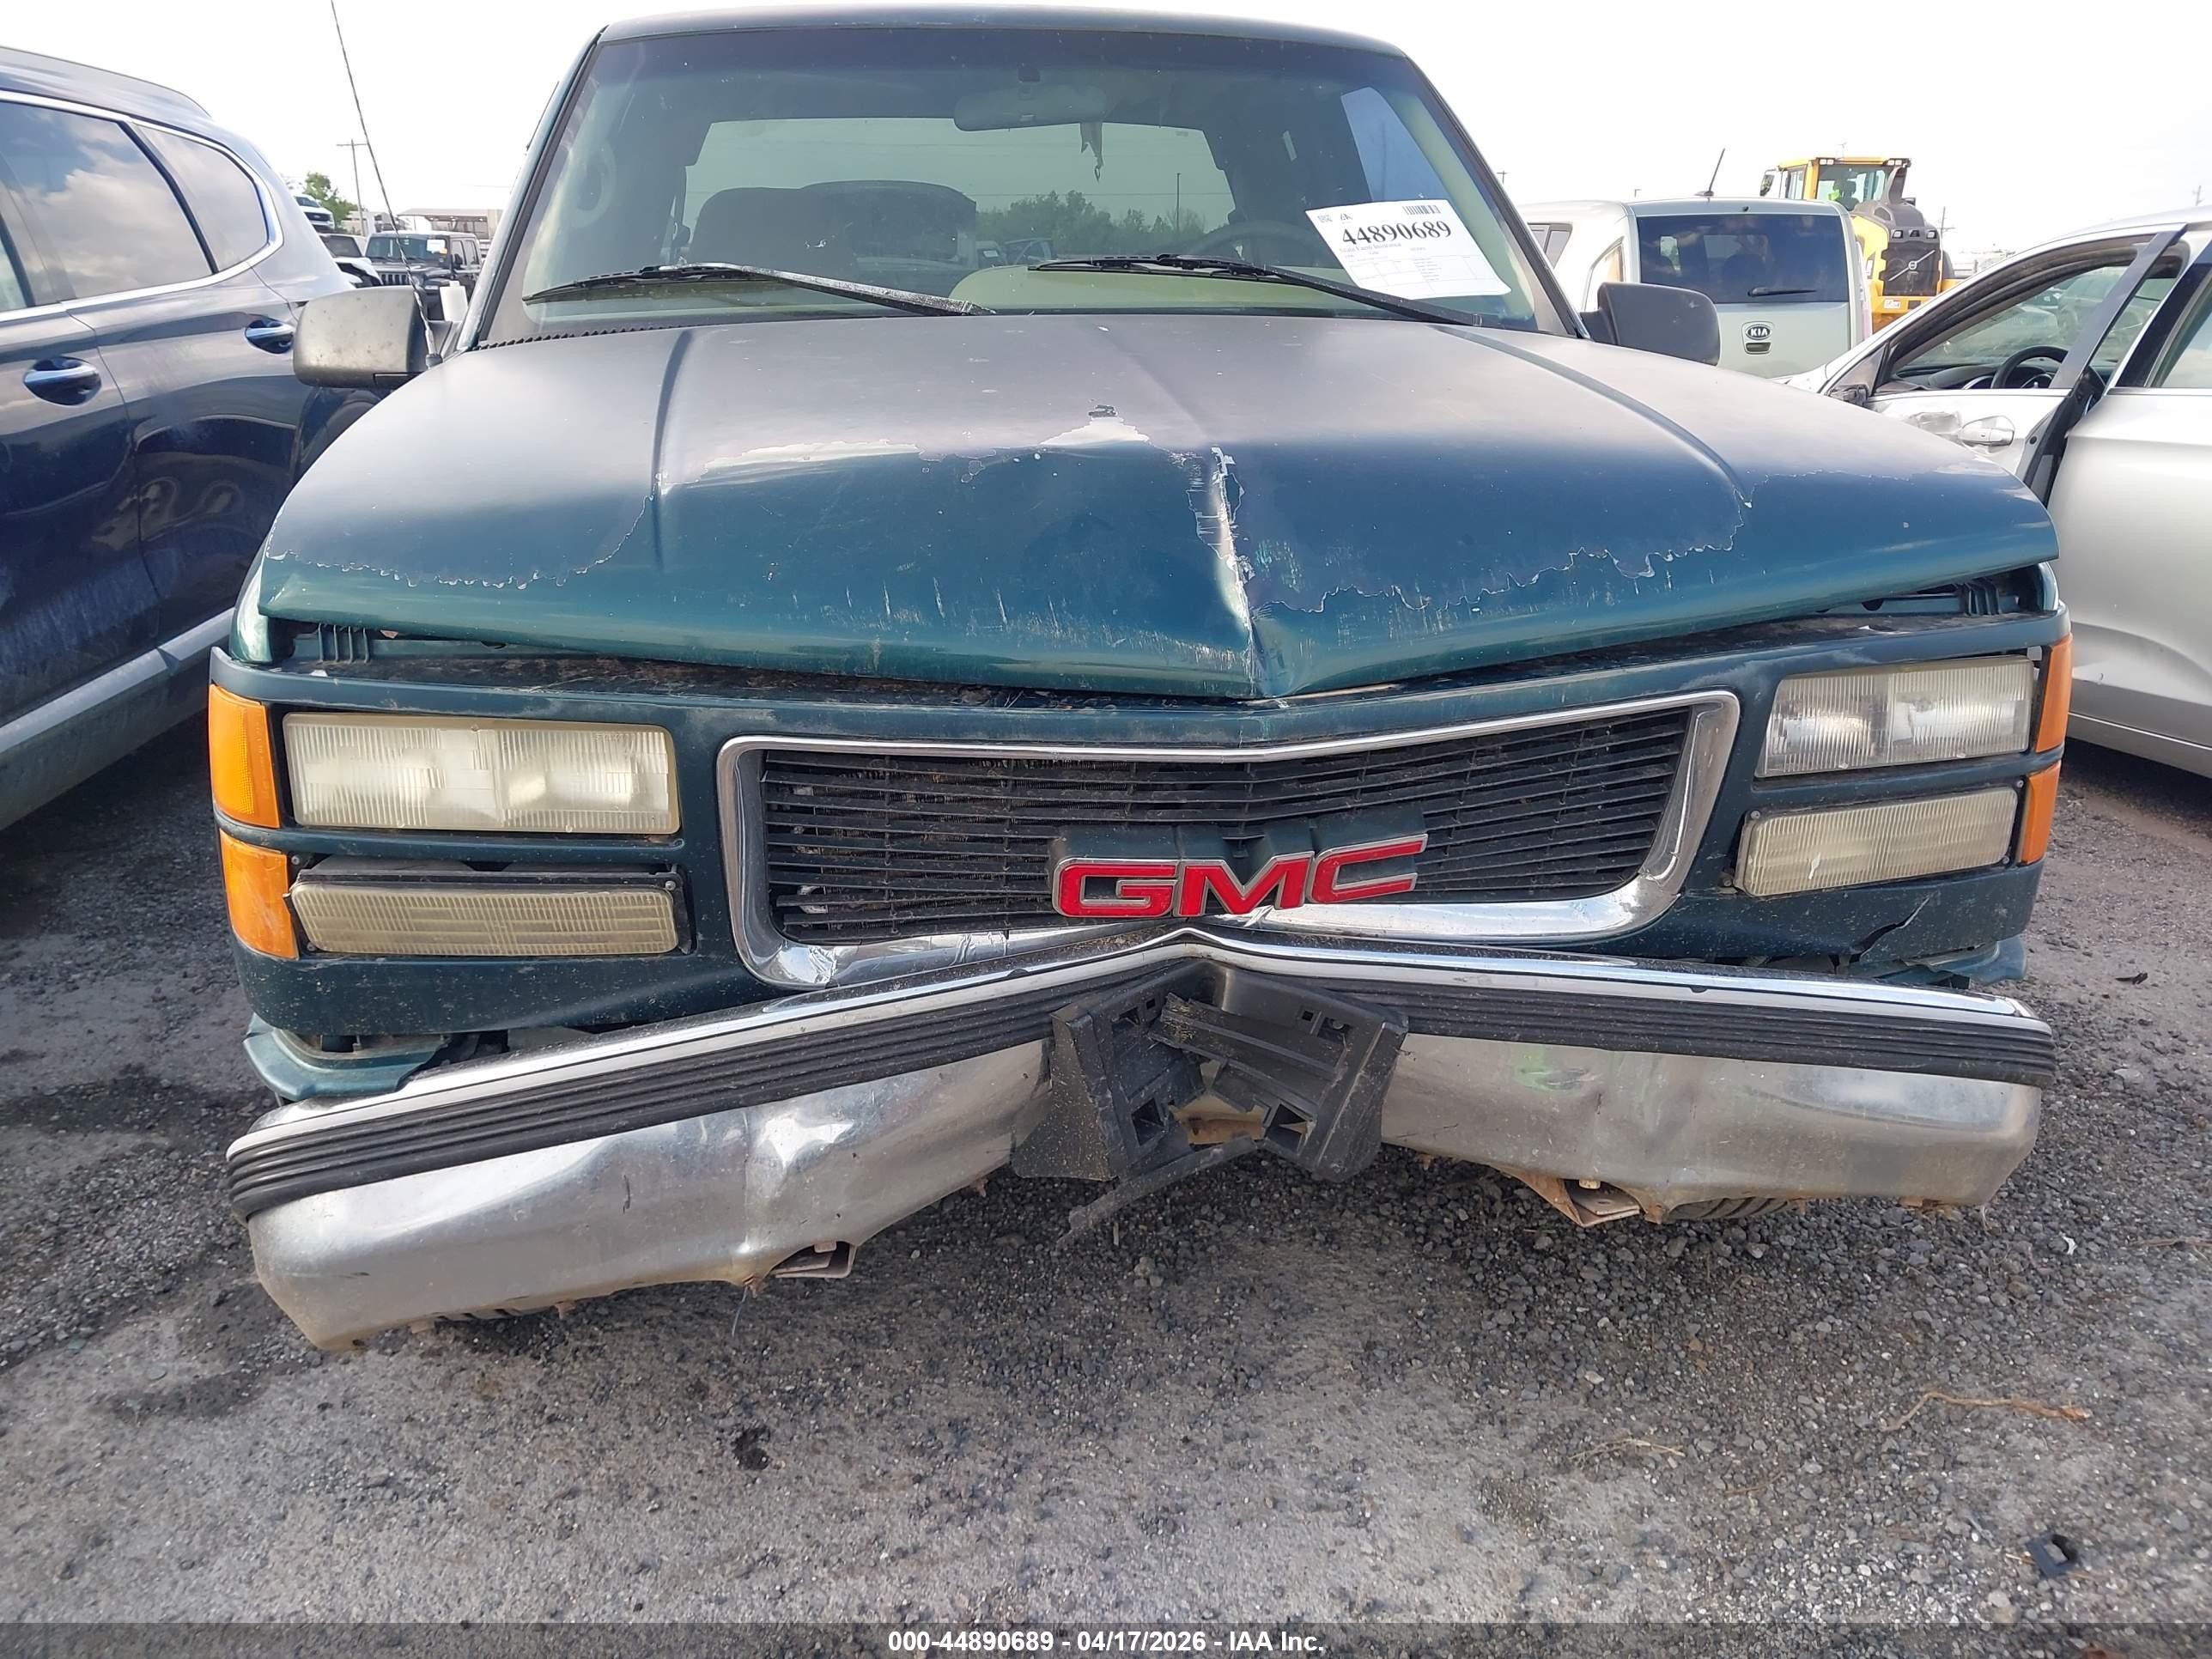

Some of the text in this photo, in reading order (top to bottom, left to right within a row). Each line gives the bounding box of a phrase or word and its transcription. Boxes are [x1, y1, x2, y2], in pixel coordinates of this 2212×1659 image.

[1342, 220, 1451, 245] 44890689
[1750, 327, 1768, 337] KIA
[1052, 833, 1428, 918] GMC
